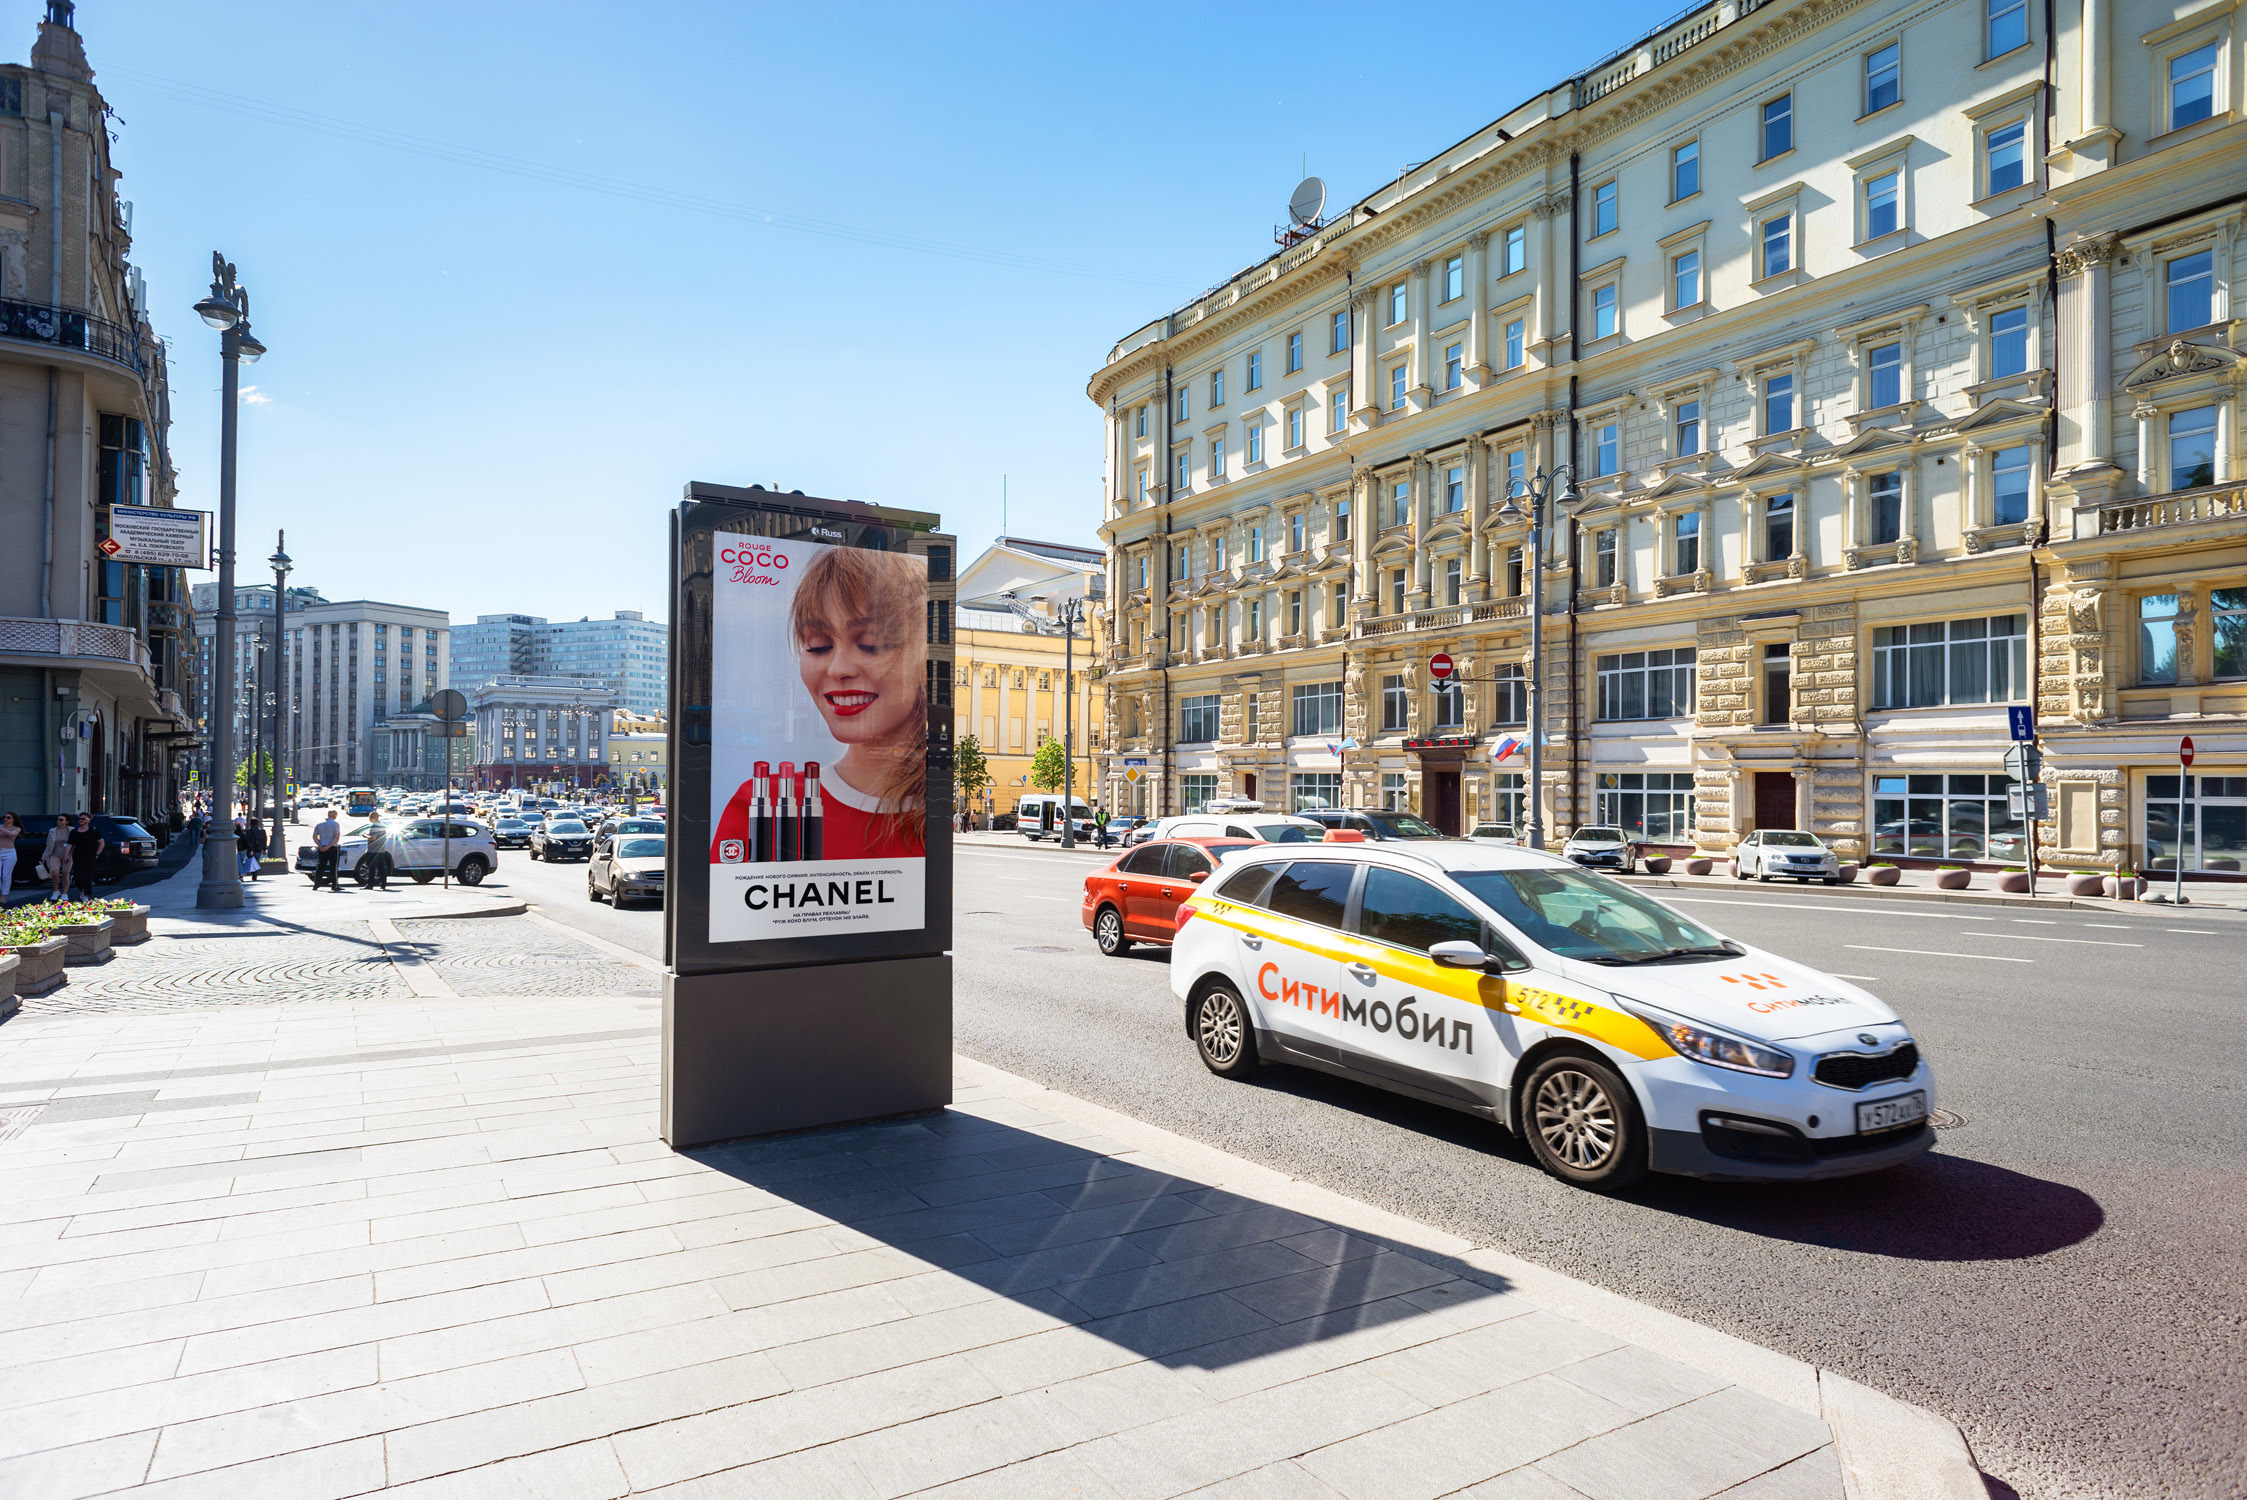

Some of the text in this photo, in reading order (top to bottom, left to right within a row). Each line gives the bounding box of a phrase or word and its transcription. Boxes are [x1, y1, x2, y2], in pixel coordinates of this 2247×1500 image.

[117, 509, 159, 517] МИНИСТЕРСТВО
[120, 529, 164, 537] АКАДЕМИЧЕСКИЙ
[151, 526, 199, 534] ГОСУДАРСТВЕННЫЙ
[821, 528, 842, 538] Russ
[129, 536, 169, 544] МУЗЫКАЛЬНЫЙ
[738, 542, 772, 552] ROUGE
[720, 548, 789, 570] COCO
[730, 566, 780, 586] Bloom
[744, 879, 894, 910] CHANEL
[1517, 988, 1548, 1010] 572
[1258, 962, 1472, 1055] Ситимобил
